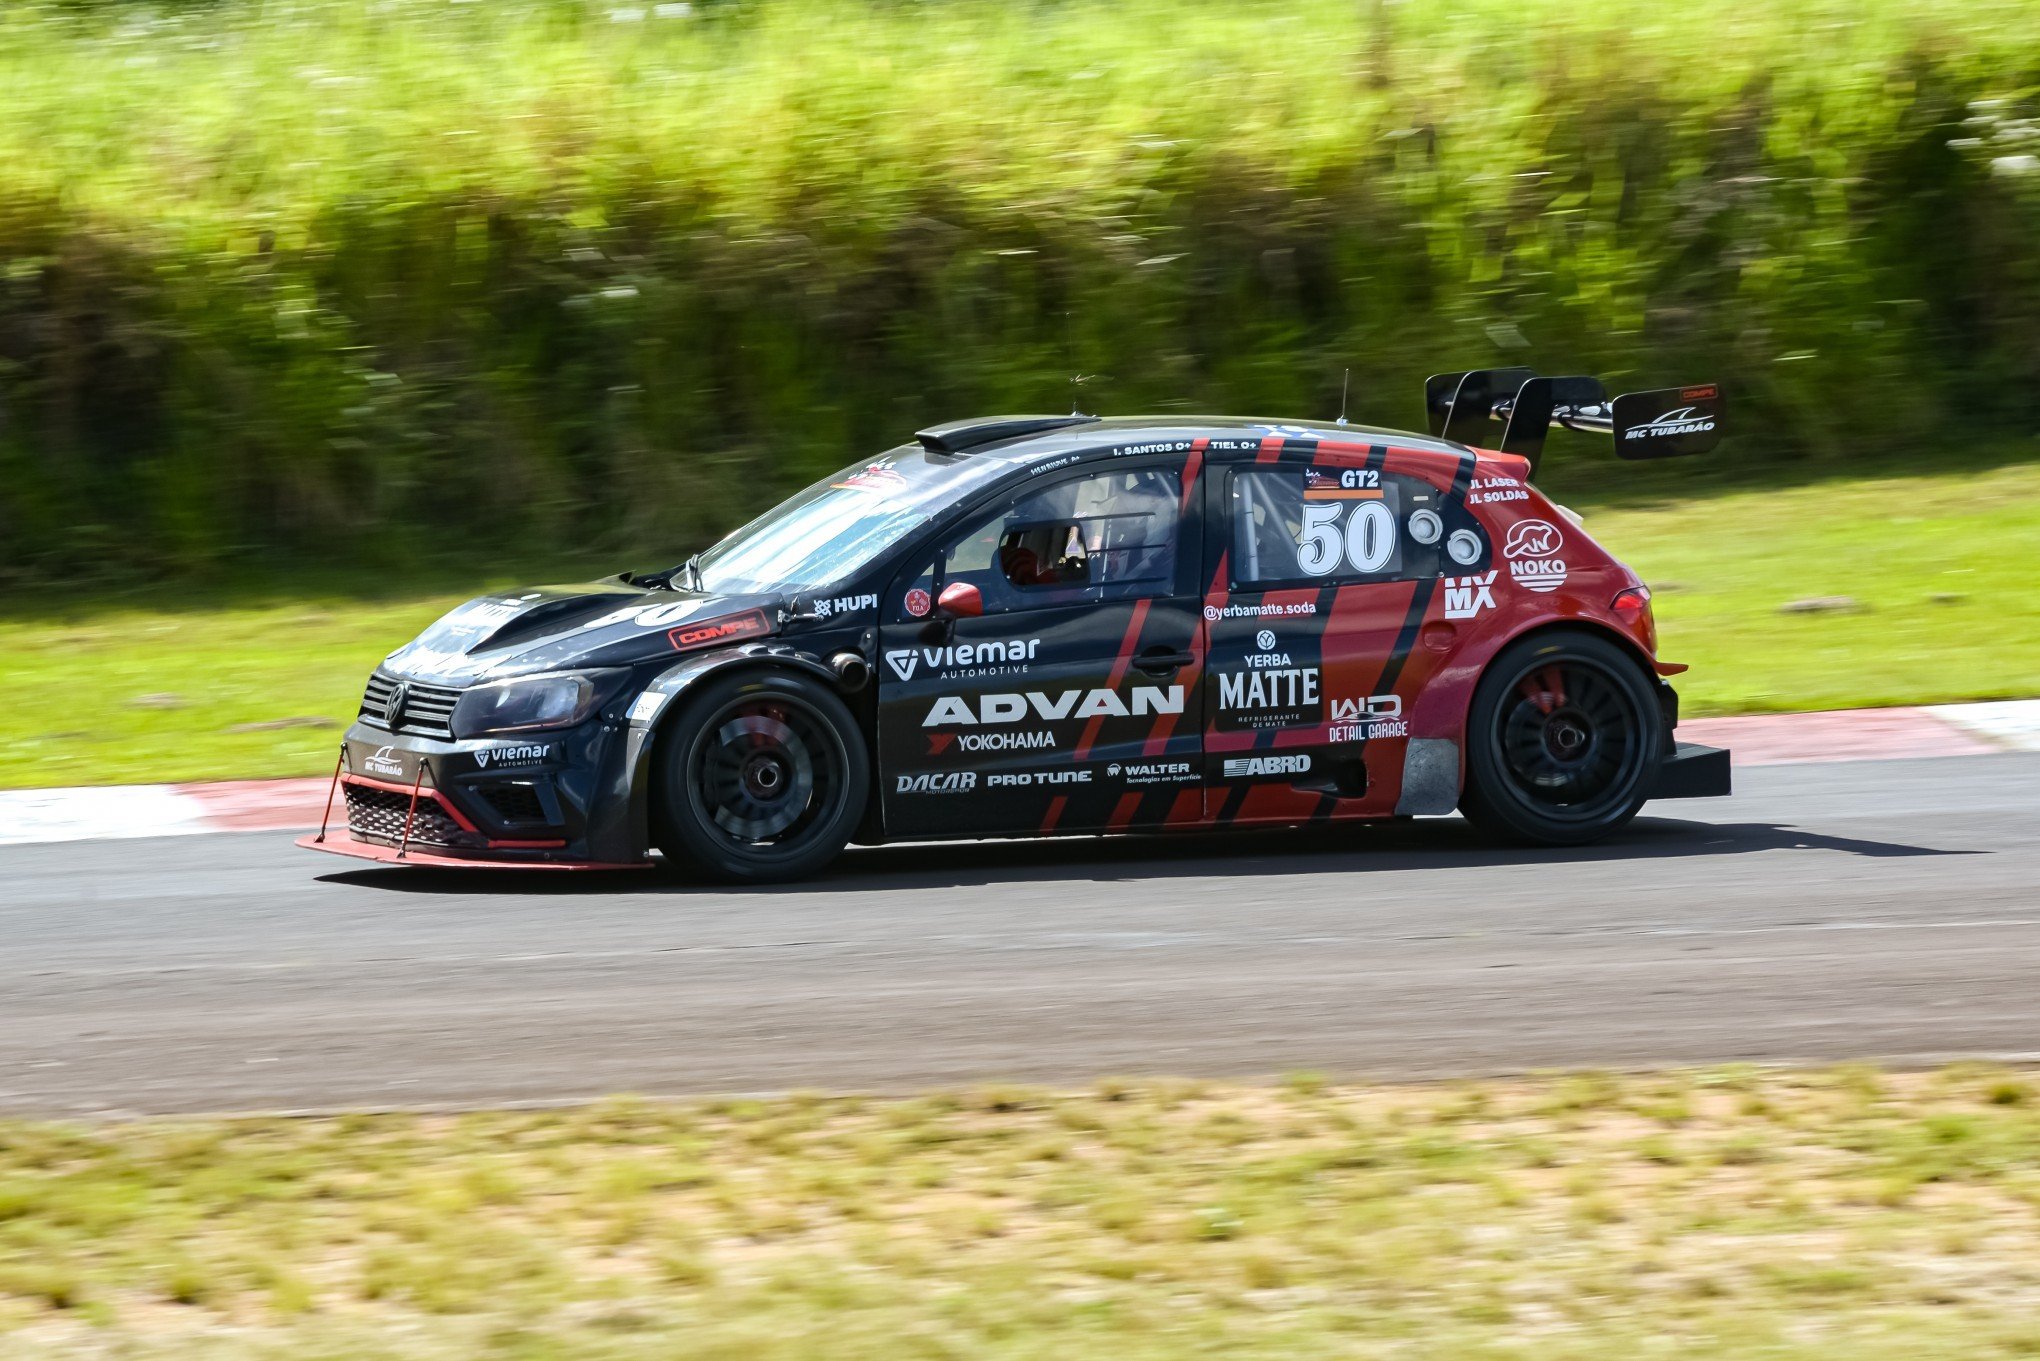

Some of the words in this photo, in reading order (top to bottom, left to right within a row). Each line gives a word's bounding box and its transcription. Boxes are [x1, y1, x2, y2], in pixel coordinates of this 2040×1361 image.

[1625, 430, 1648, 440] MC
[1124, 443, 1172, 455] SANTOS
[1210, 442, 1238, 450] TIEL
[1342, 470, 1379, 488] GT2
[1470, 479, 1483, 489] JL
[1484, 478, 1520, 488] LASER
[1470, 494, 1482, 504] JL
[1484, 490, 1529, 502] SOLDAS
[1296, 500, 1396, 576] 50
[1510, 560, 1566, 575] NOKO
[1444, 570, 1498, 618] MX
[834, 594, 877, 613] HUPI
[1204, 602, 1316, 620] @yerbamatte.soda
[678, 617, 760, 644] COMPE
[1244, 653, 1292, 668] YERBA
[940, 664, 1028, 680] AUTOMOTIVE
[1219, 668, 1320, 710] MATTE
[922, 685, 1184, 727] ADVAN
[1238, 714, 1300, 722] REFRIGERANTE
[1330, 726, 1365, 742] DETAIL
[1368, 721, 1408, 739] GARAGE
[958, 731, 1055, 752] YOKOHAMA
[1125, 763, 1190, 776] WALTER
[1246, 754, 1310, 775] ABRO
[896, 772, 977, 792] DACAR
[988, 774, 1032, 786] PRO
